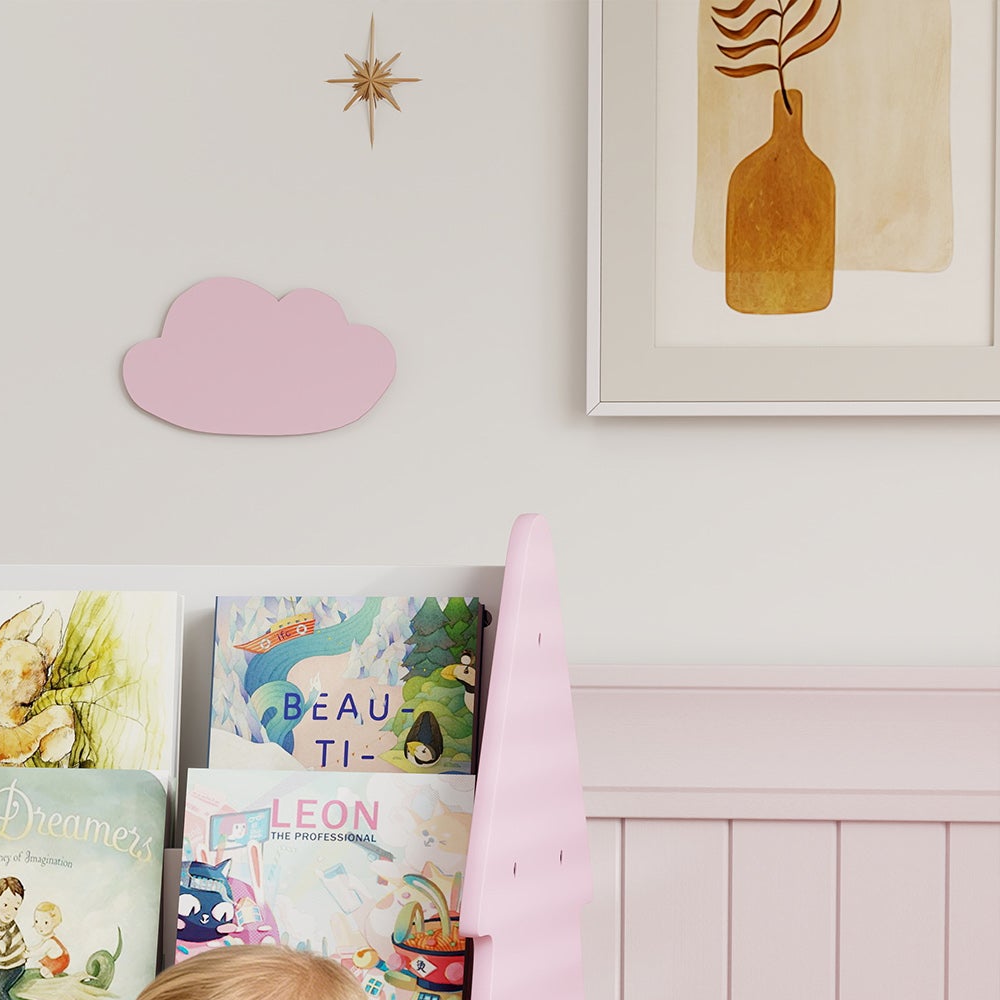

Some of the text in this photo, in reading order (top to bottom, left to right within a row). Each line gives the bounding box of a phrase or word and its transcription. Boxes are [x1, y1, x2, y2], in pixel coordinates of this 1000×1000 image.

[315, 739, 375, 768] TI-
[271, 799, 379, 830] LEON
[271, 832, 377, 844] THE PROFESSIONAL
[13, 850, 24, 862] of
[25, 850, 73, 869] Imagination
